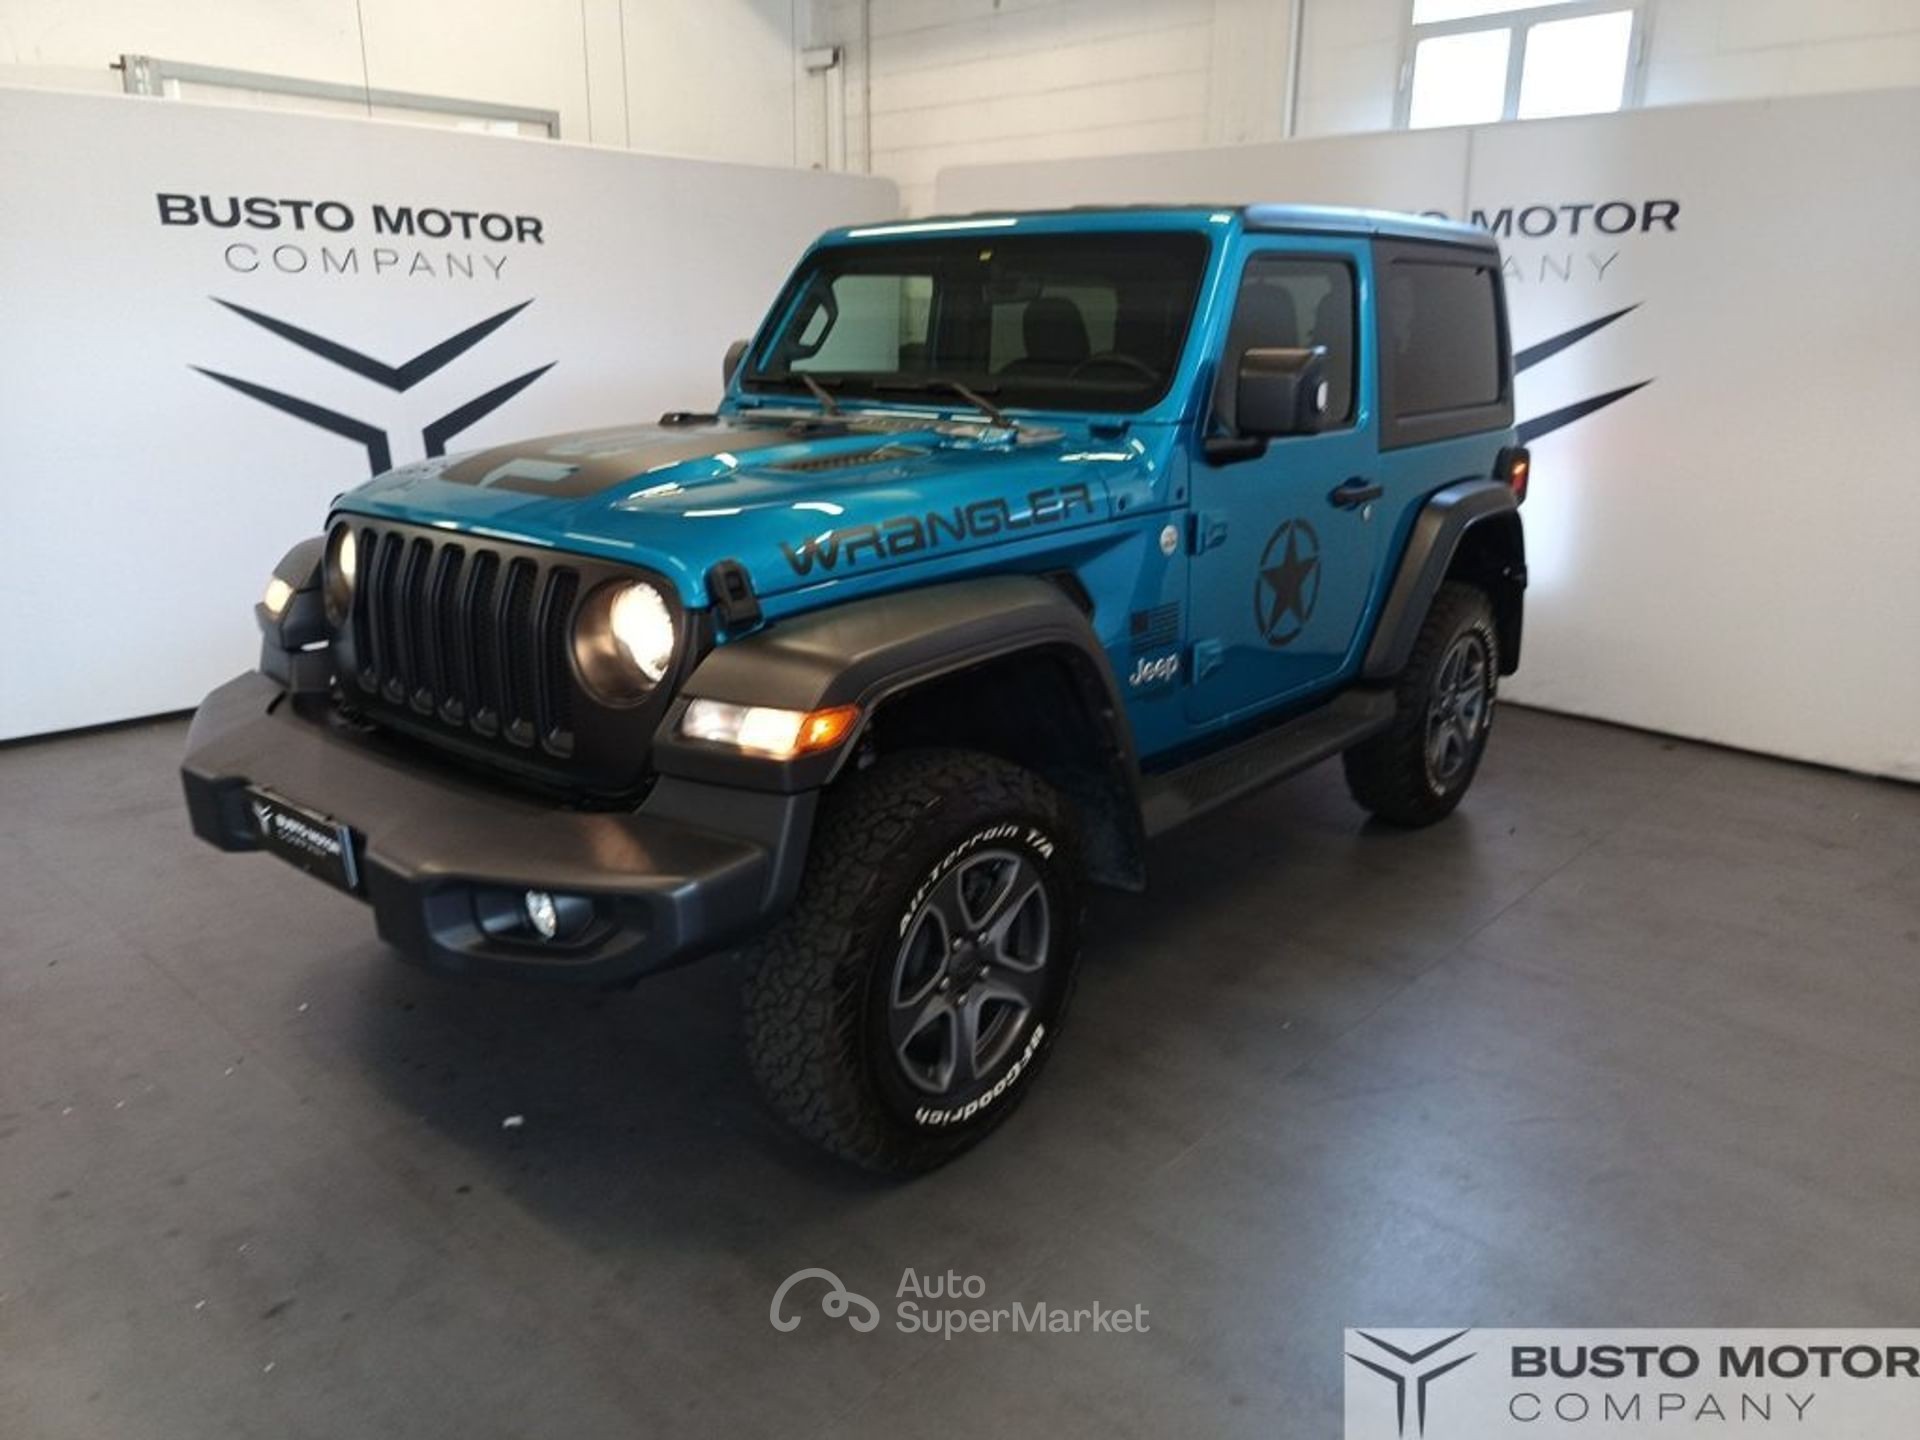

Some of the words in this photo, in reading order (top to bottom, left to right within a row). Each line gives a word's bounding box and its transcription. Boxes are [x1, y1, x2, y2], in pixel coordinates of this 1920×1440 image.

[156, 193, 355, 233] BUSTO
[372, 205, 545, 244] MOTOR
[1471, 199, 1681, 238] MOTOR
[224, 243, 508, 280] COMPANY
[1129, 652, 1178, 686] Jeep
